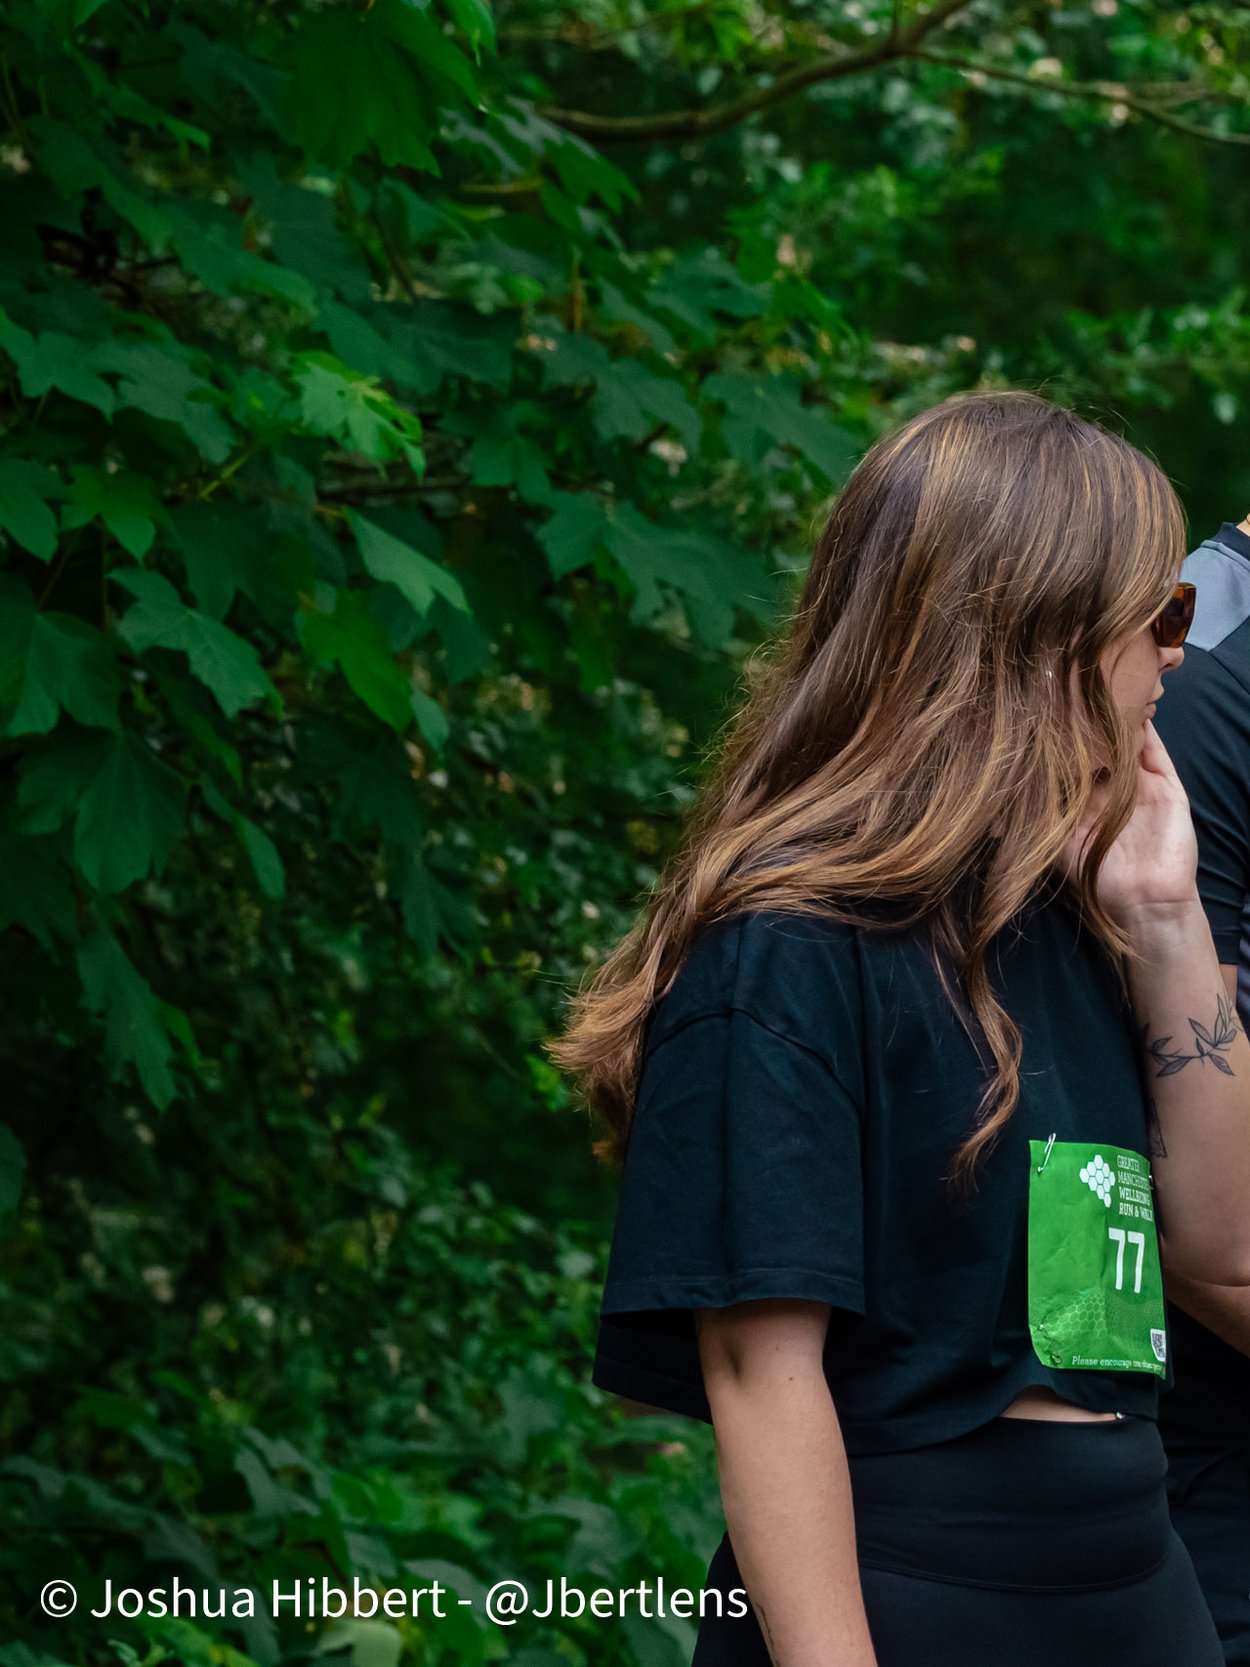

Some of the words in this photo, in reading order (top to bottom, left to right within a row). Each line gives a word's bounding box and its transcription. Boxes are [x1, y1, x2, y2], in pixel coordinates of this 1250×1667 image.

[1118, 1202, 1133, 1216] RUN
[1134, 1205, 1139, 1217] &
[1108, 1227, 1144, 1294] 77
[1072, 1355, 1098, 1365] Please
[1100, 1359, 1131, 1368] encourage
